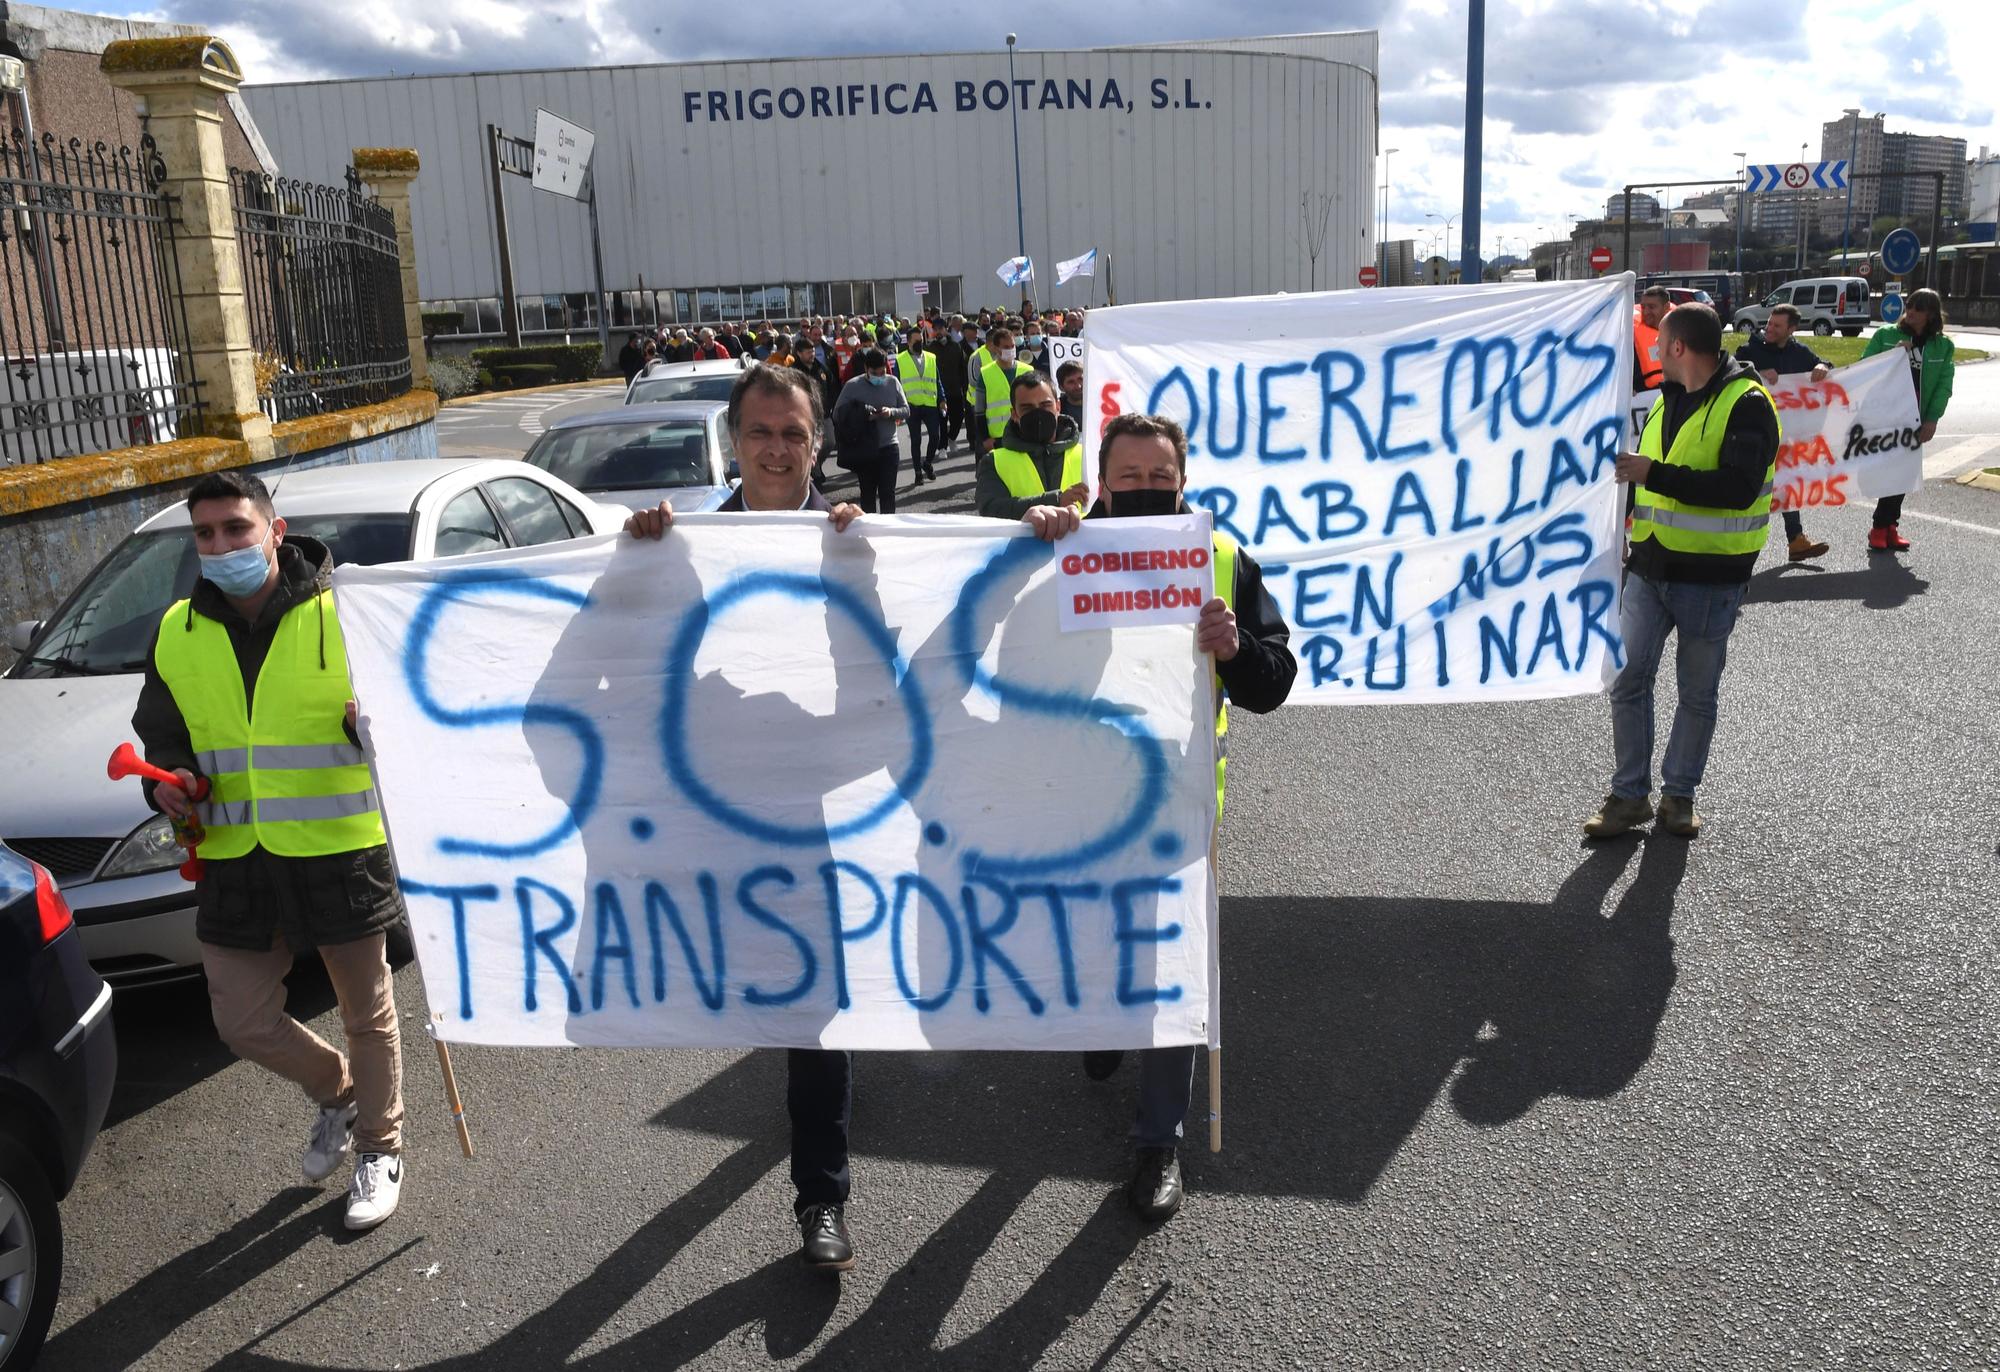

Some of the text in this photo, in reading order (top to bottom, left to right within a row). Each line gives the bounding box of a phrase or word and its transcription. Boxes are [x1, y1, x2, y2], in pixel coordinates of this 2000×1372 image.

[684, 78, 1212, 123] FRIGORIFICA BOTANA, S.L.
[1790, 171, 1796, 181] 5
[1147, 314, 1616, 462] QUEREMOS
[1843, 424, 1922, 460] PRECIOS
[1184, 417, 1624, 546] RABALLAR
[1061, 547, 1209, 576] GOBIERNO
[1073, 583, 1202, 615] DIMISIÓN
[1428, 512, 1594, 617] NOS
[402, 536, 1184, 880] S.O.S.
[402, 862, 1184, 1022] TRANSPORTE
